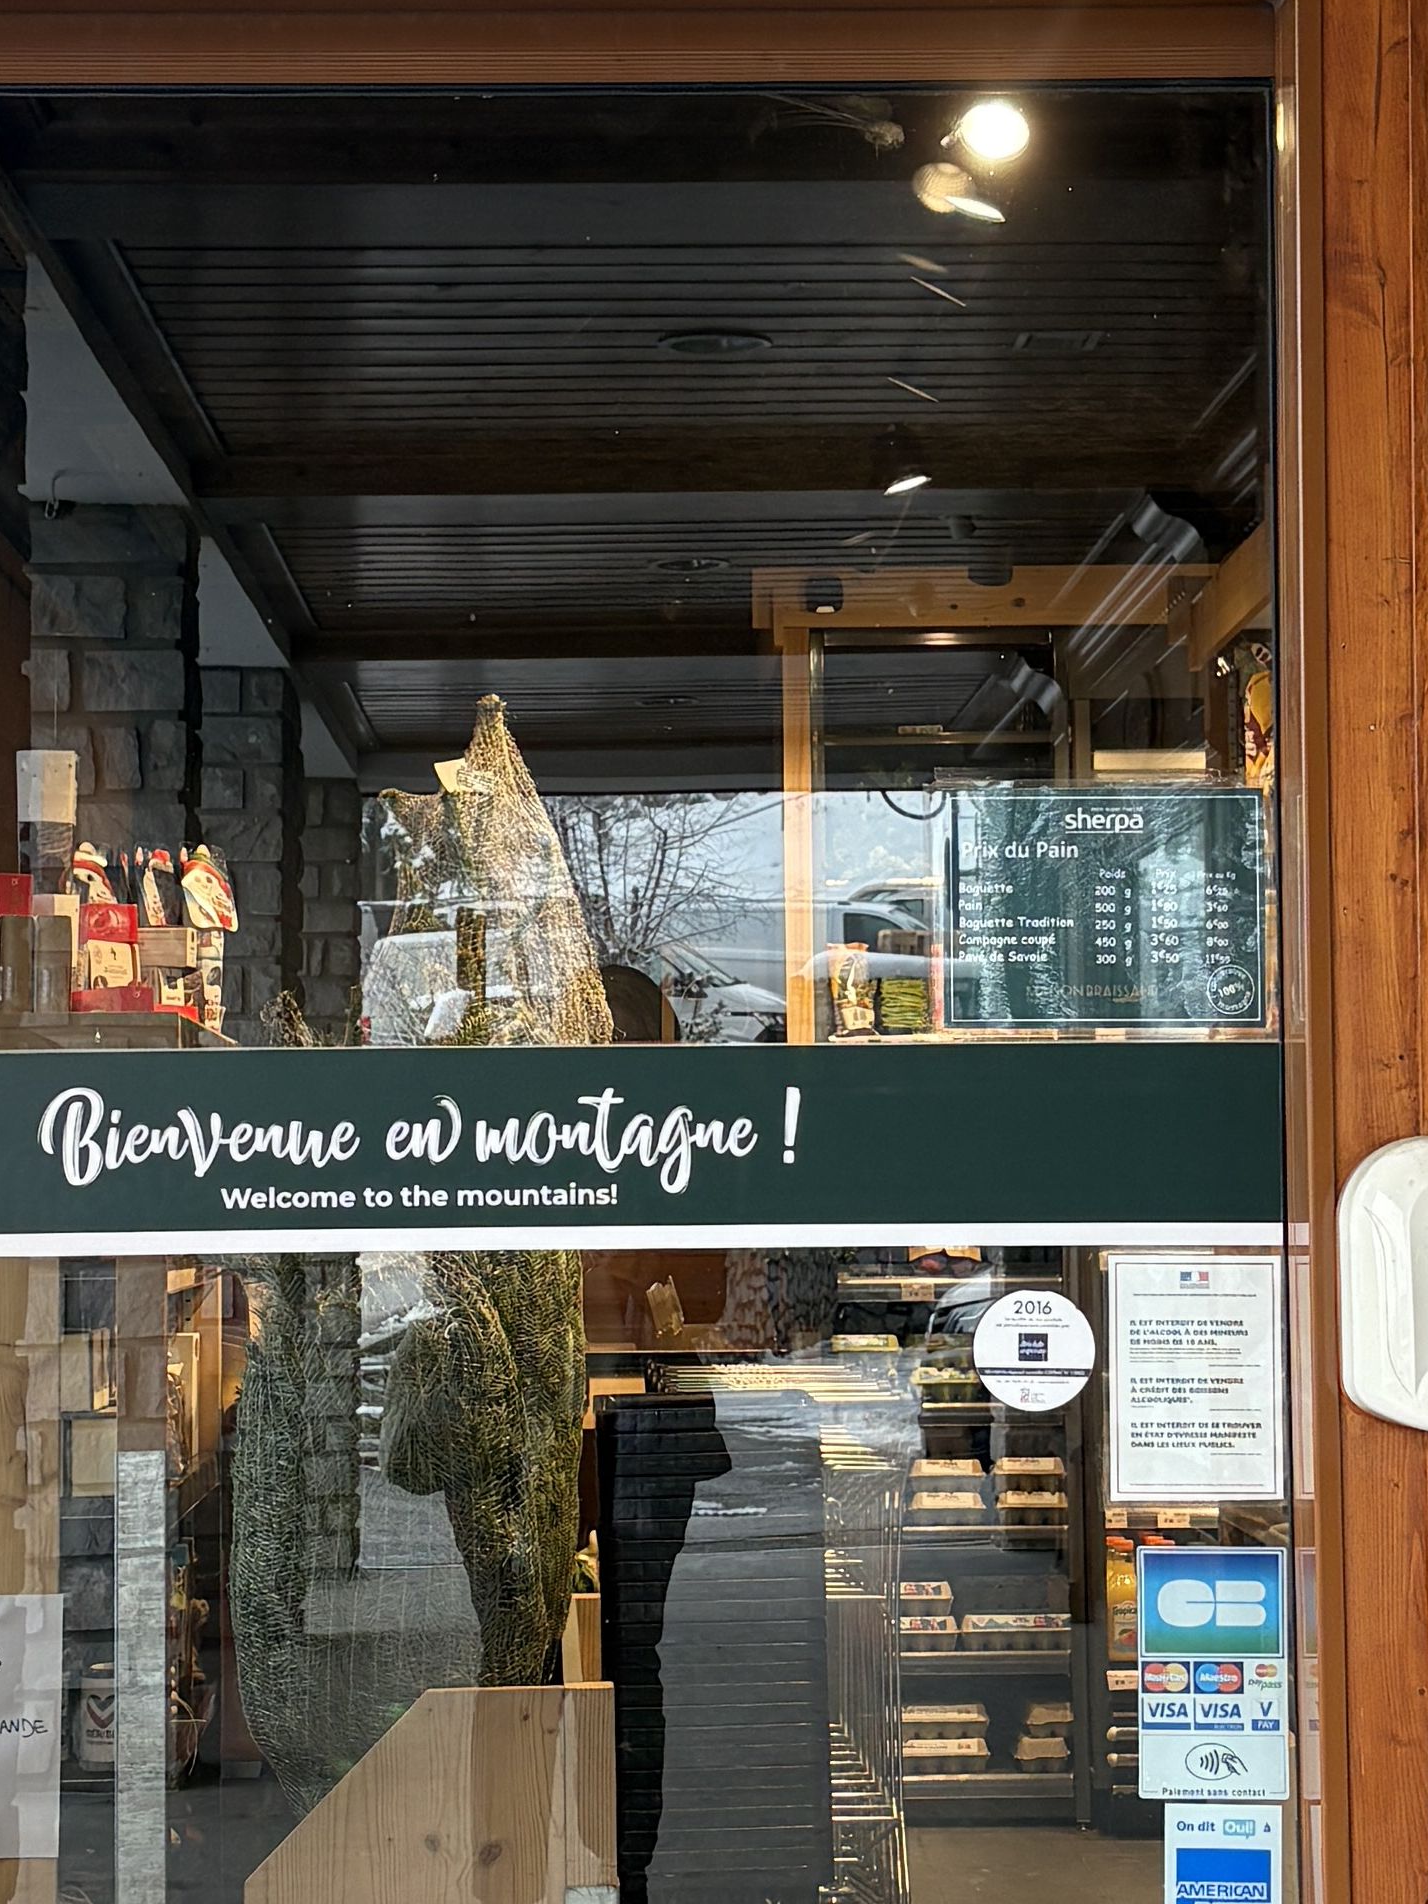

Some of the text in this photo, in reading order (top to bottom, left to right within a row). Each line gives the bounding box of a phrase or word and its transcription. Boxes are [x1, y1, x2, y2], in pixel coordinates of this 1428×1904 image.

[1064, 807, 1144, 834] sherpa
[960, 840, 1079, 859] Prix du Pain
[1099, 868, 1126, 879] Poids
[958, 882, 1014, 896] Baguette
[1094, 885, 1117, 896] 200
[1123, 887, 1132, 899] g
[958, 898, 983, 911] Pain
[1094, 902, 1116, 913] 500
[1123, 904, 1132, 916] g
[958, 916, 1014, 931] Baguette
[1016, 916, 1075, 928] Tradition
[1094, 919, 1117, 930] 250
[1123, 922, 1132, 933] g
[958, 933, 1018, 948] Campagne
[1020, 932, 1056, 948] coupé
[1094, 936, 1117, 948] 450
[1124, 939, 1133, 951] g
[988, 950, 1005, 963] de
[1007, 950, 1048, 963] Savoie
[1095, 954, 1117, 965] 300
[1124, 956, 1133, 967] g
[1217, 980, 1246, 998] 100%
[384, 1094, 462, 1167] en
[474, 1087, 759, 1196] montagne
[781, 1085, 802, 1165] !
[220, 1181, 620, 1211] Welcome to the mountains!
[1013, 1300, 1053, 1315] 2016
[1157, 1578, 1267, 1628] CB
[1198, 1672, 1238, 1683] Maestro
[1147, 1701, 1273, 1719] VISA VISA V
[1257, 1720, 1275, 1730] PAY
[1161, 1787, 1266, 1797] Paiement sans contact
[1176, 1820, 1194, 1832] On
[1197, 1820, 1216, 1832] dit
[1224, 1820, 1254, 1834] Oui!
[1176, 1882, 1265, 1898] AMERICAN
